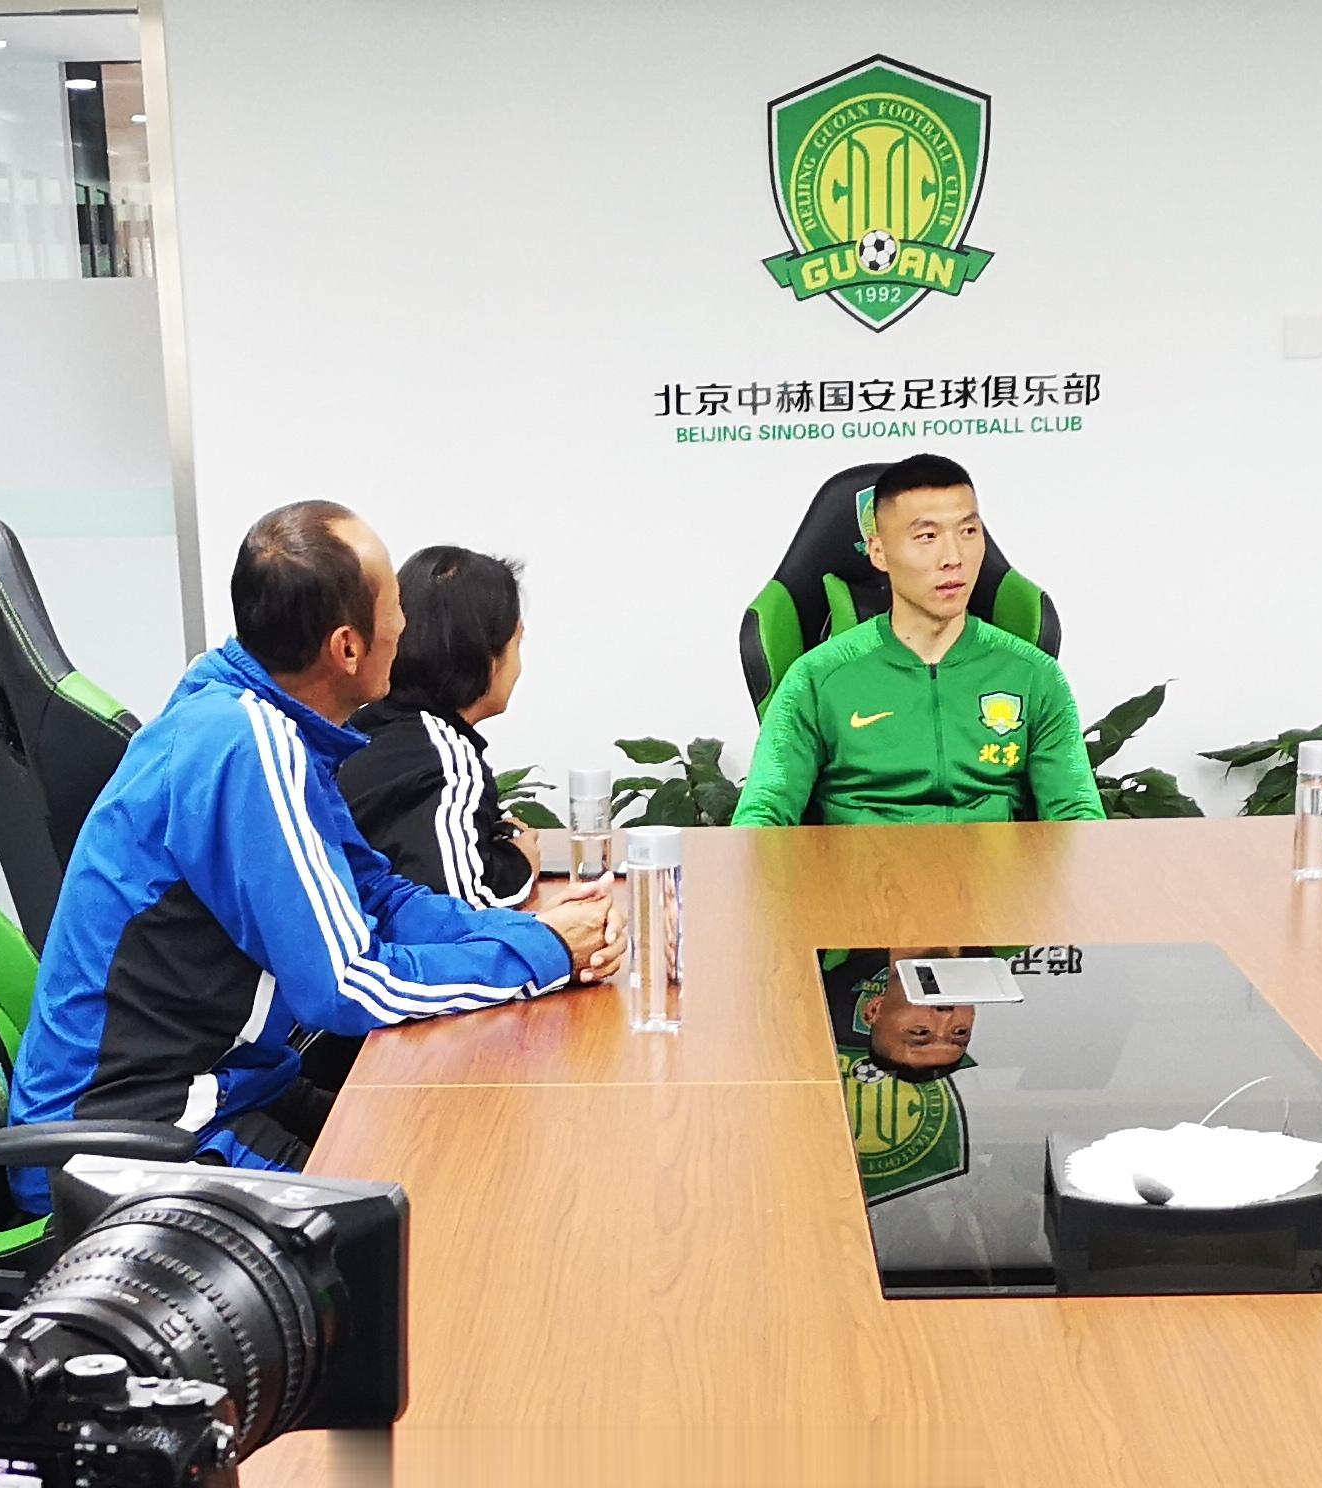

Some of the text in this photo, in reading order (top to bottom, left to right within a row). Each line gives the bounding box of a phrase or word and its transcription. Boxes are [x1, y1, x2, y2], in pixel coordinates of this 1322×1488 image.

[797, 101, 959, 231] BEIJING GUOAN FOOTBALL CLUB
[855, 286, 901, 303] 1992
[654, 373, 1101, 416] 北京中赫国安足球俱乐部
[676, 416, 1082, 442] BEIJING SINOBO GUOAN FOOTBALL CLUB
[979, 742, 1020, 767] 北京
